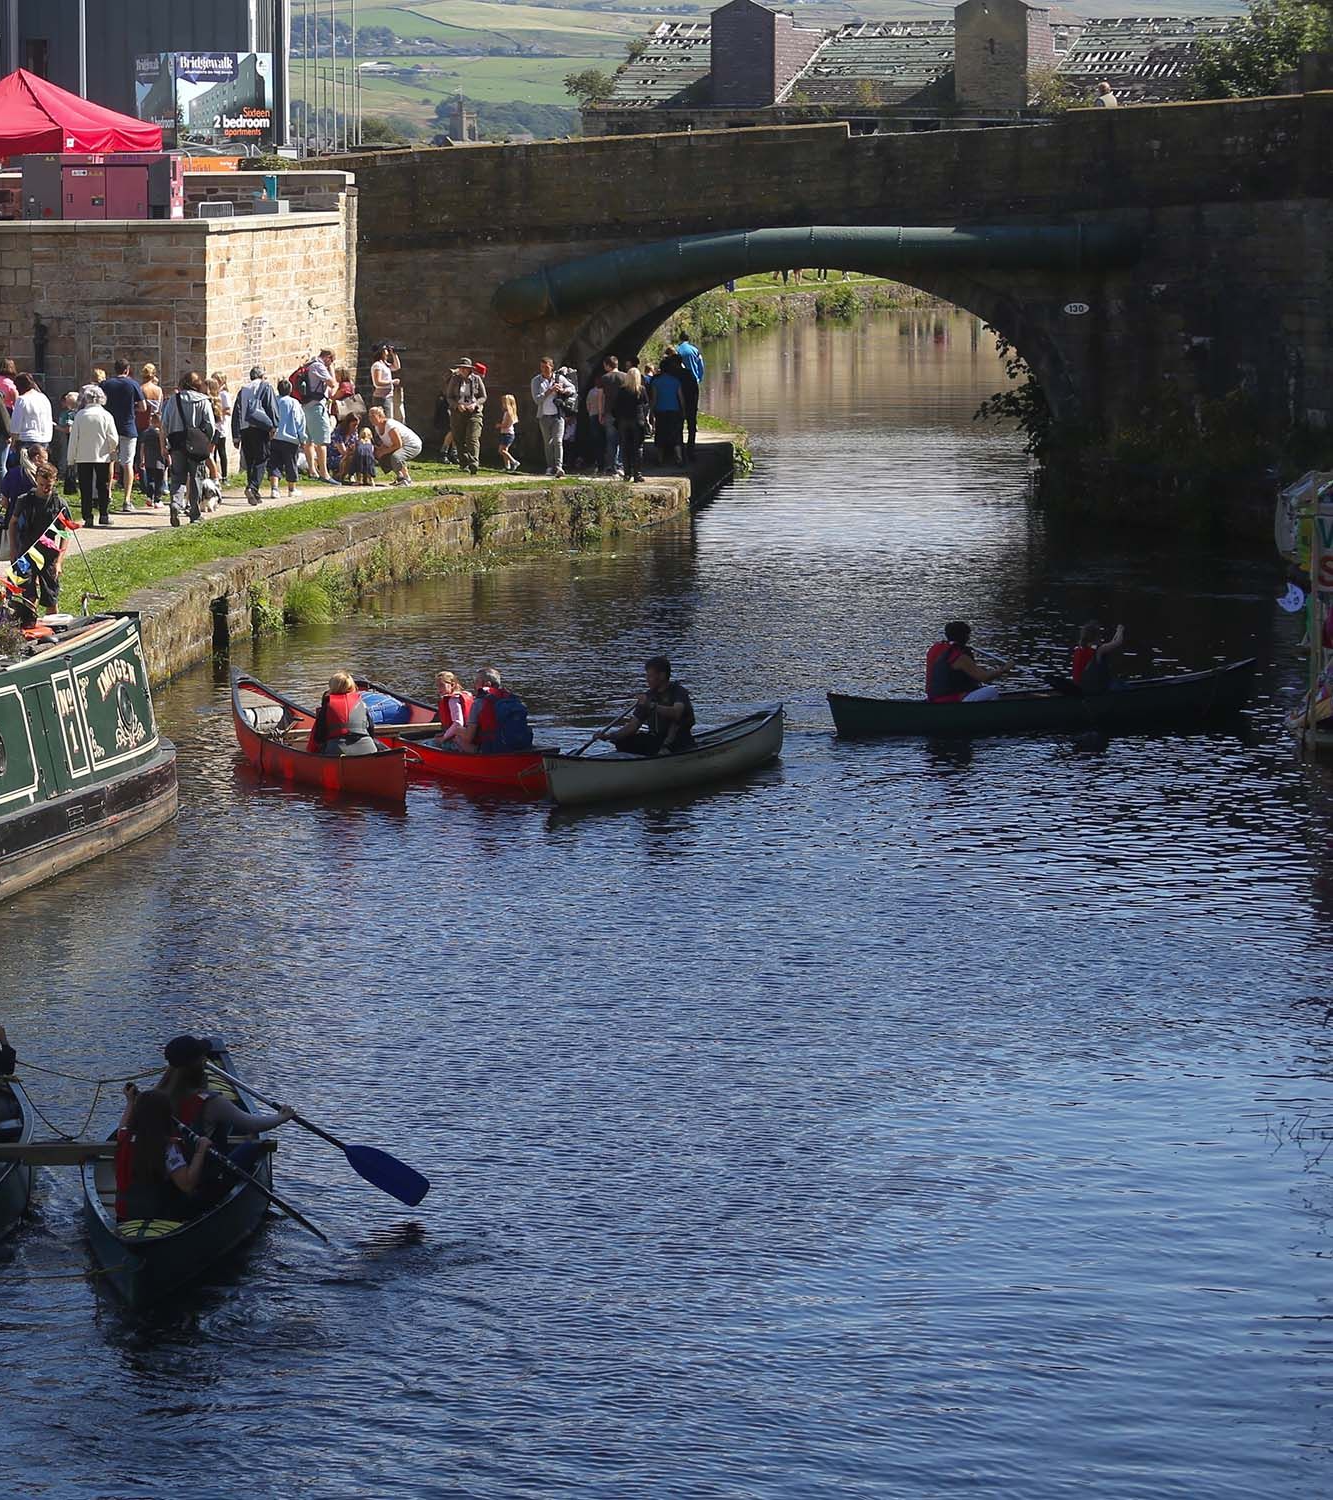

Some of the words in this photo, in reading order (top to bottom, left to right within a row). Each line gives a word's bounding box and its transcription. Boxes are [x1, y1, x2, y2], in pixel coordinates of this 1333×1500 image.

[180, 55, 233, 70] Bridgewalk
[243, 107, 271, 118] Sixteen
[213, 115, 221, 128] 2
[223, 113, 270, 128] bedroom
[224, 128, 262, 138] apartments
[1069, 304, 1084, 313] 130
[96, 658, 136, 702] IMOGEN
[70, 721, 79, 753] 1
